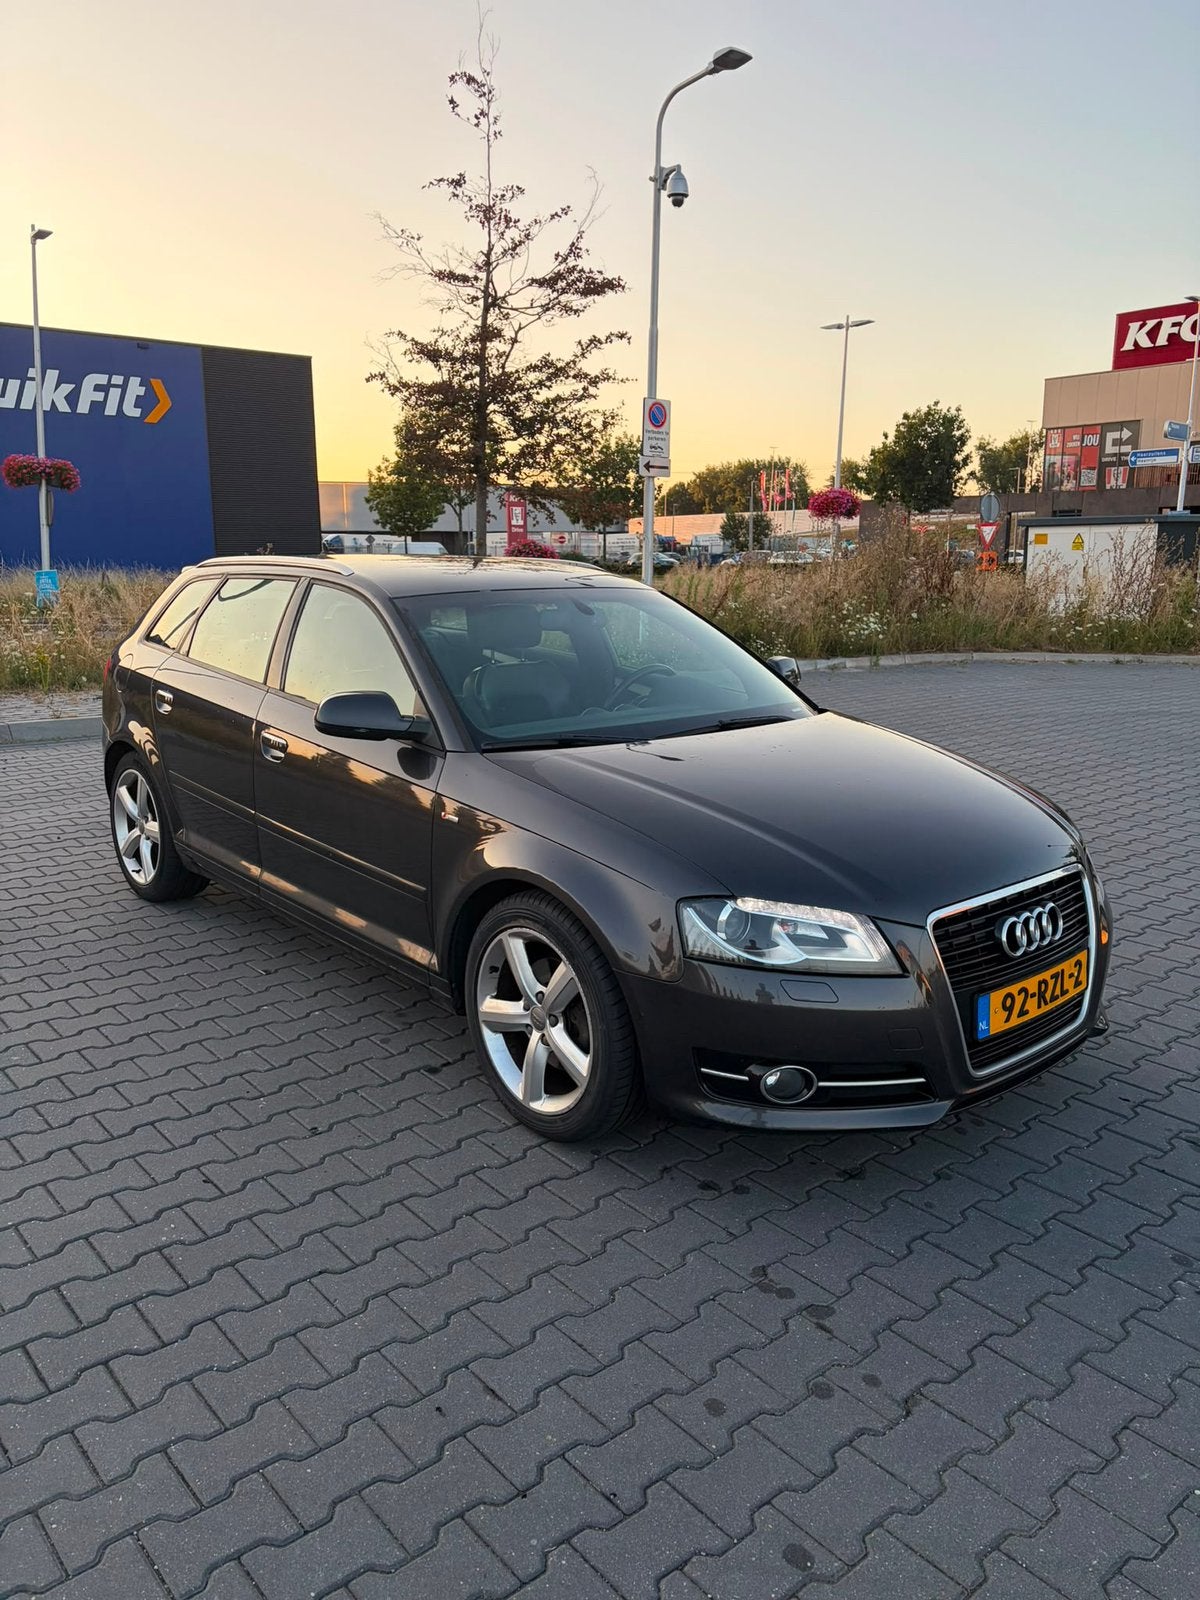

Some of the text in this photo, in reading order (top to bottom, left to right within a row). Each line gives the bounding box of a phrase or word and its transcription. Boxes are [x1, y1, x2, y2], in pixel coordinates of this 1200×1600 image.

[1120, 313, 1200, 351] KFC
[1082, 434, 1100, 447] JOU
[1001, 958, 1083, 1024] 92-RZL-2
[978, 1020, 989, 1031] NL
